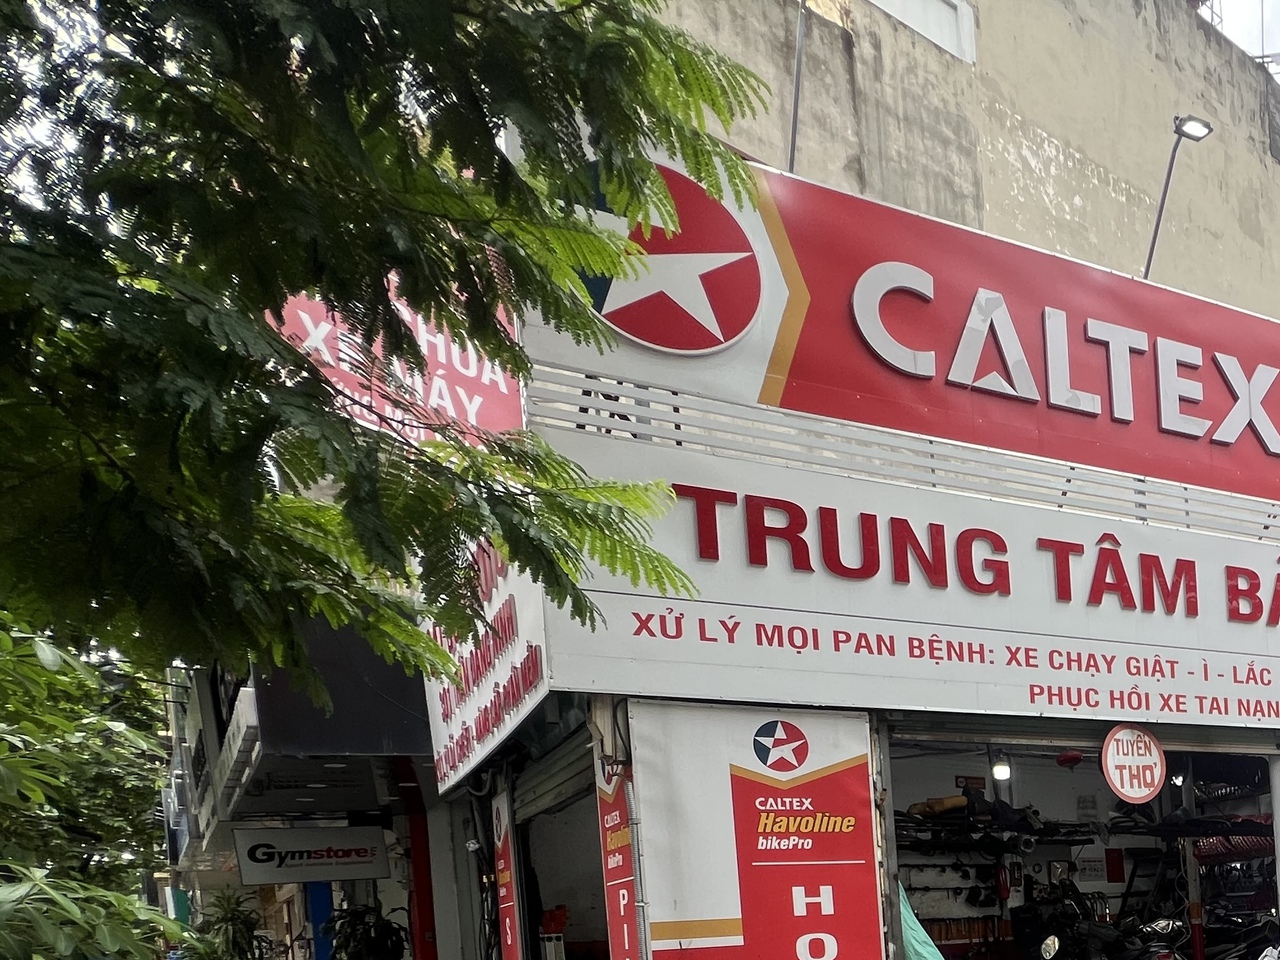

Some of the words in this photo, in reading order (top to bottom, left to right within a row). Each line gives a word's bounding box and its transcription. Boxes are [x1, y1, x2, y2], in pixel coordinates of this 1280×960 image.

[672, 483, 1011, 598] TRUNG
[1036, 532, 1200, 618] TÂM
[631, 607, 685, 640] XỬ
[698, 615, 742, 645] LÝ
[755, 622, 820, 655] MỌI
[833, 630, 896, 658] PAN
[908, 633, 996, 666] BỆNH:
[1004, 645, 1039, 669] XE
[1048, 649, 1117, 679] CHẠY
[1125, 653, 1179, 683] GIẬT
[1232, 660, 1273, 687] LẮC
[1029, 684, 1100, 710] PHỤC
[1109, 684, 1151, 711] HỒI
[1158, 693, 1187, 714] XE
[1194, 695, 1229, 716] TAI
[1237, 697, 1280, 722] NẠN
[1113, 734, 1153, 757] TUYỂN
[1115, 762, 1158, 791] THỢ
[755, 797, 814, 810] CALTEX
[757, 812, 856, 833] Havoline
[757, 835, 813, 850] bikePro
